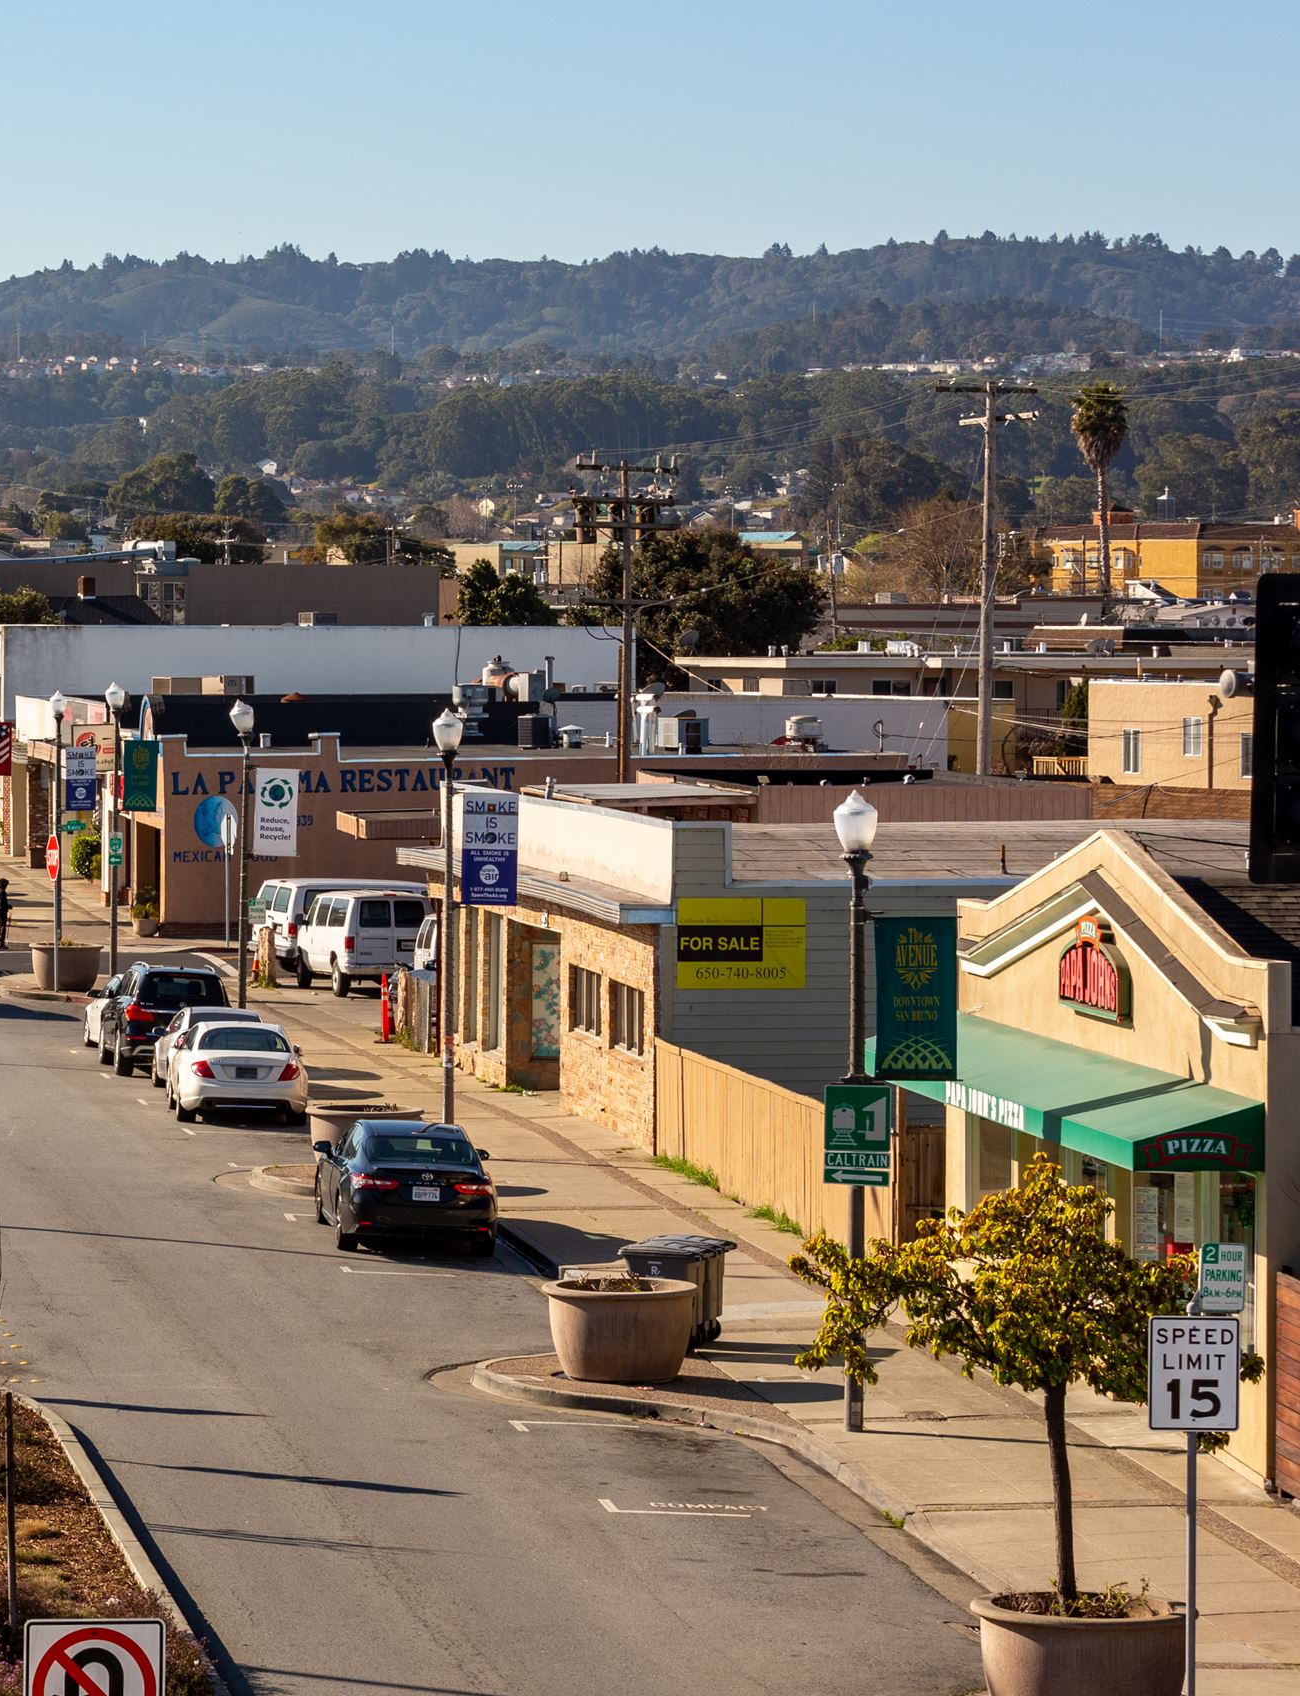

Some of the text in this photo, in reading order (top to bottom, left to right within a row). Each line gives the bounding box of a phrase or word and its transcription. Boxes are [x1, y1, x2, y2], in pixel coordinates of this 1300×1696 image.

[171, 771, 209, 795] LA
[218, 769, 332, 795] PAMA
[260, 816, 290, 825] Reduce,
[485, 816, 498, 829] IS
[260, 825, 285, 833] Reuse,
[259, 833, 291, 841] Recycle!
[907, 928, 924, 944] The
[680, 937, 713, 951] FOR
[718, 937, 760, 951] SALE
[895, 944, 938, 967] AVENUE
[695, 967, 787, 980] 650-740-8005
[892, 995, 940, 1008] DOWNTOWN
[895, 1009, 938, 1022] SAN BRUNO
[945, 1080, 1024, 1131] PAPA JOHN'S PIZZA
[1166, 1138, 1228, 1155] PIZZA
[826, 1153, 888, 1167] CALTRAIN
[1205, 1246, 1243, 1262] 2 HOUR
[1204, 1269, 1243, 1282] PARKING
[1156, 1328, 1234, 1345] SPEED
[1163, 1353, 1226, 1370] LIMIT
[1166, 1378, 1221, 1420] 15
